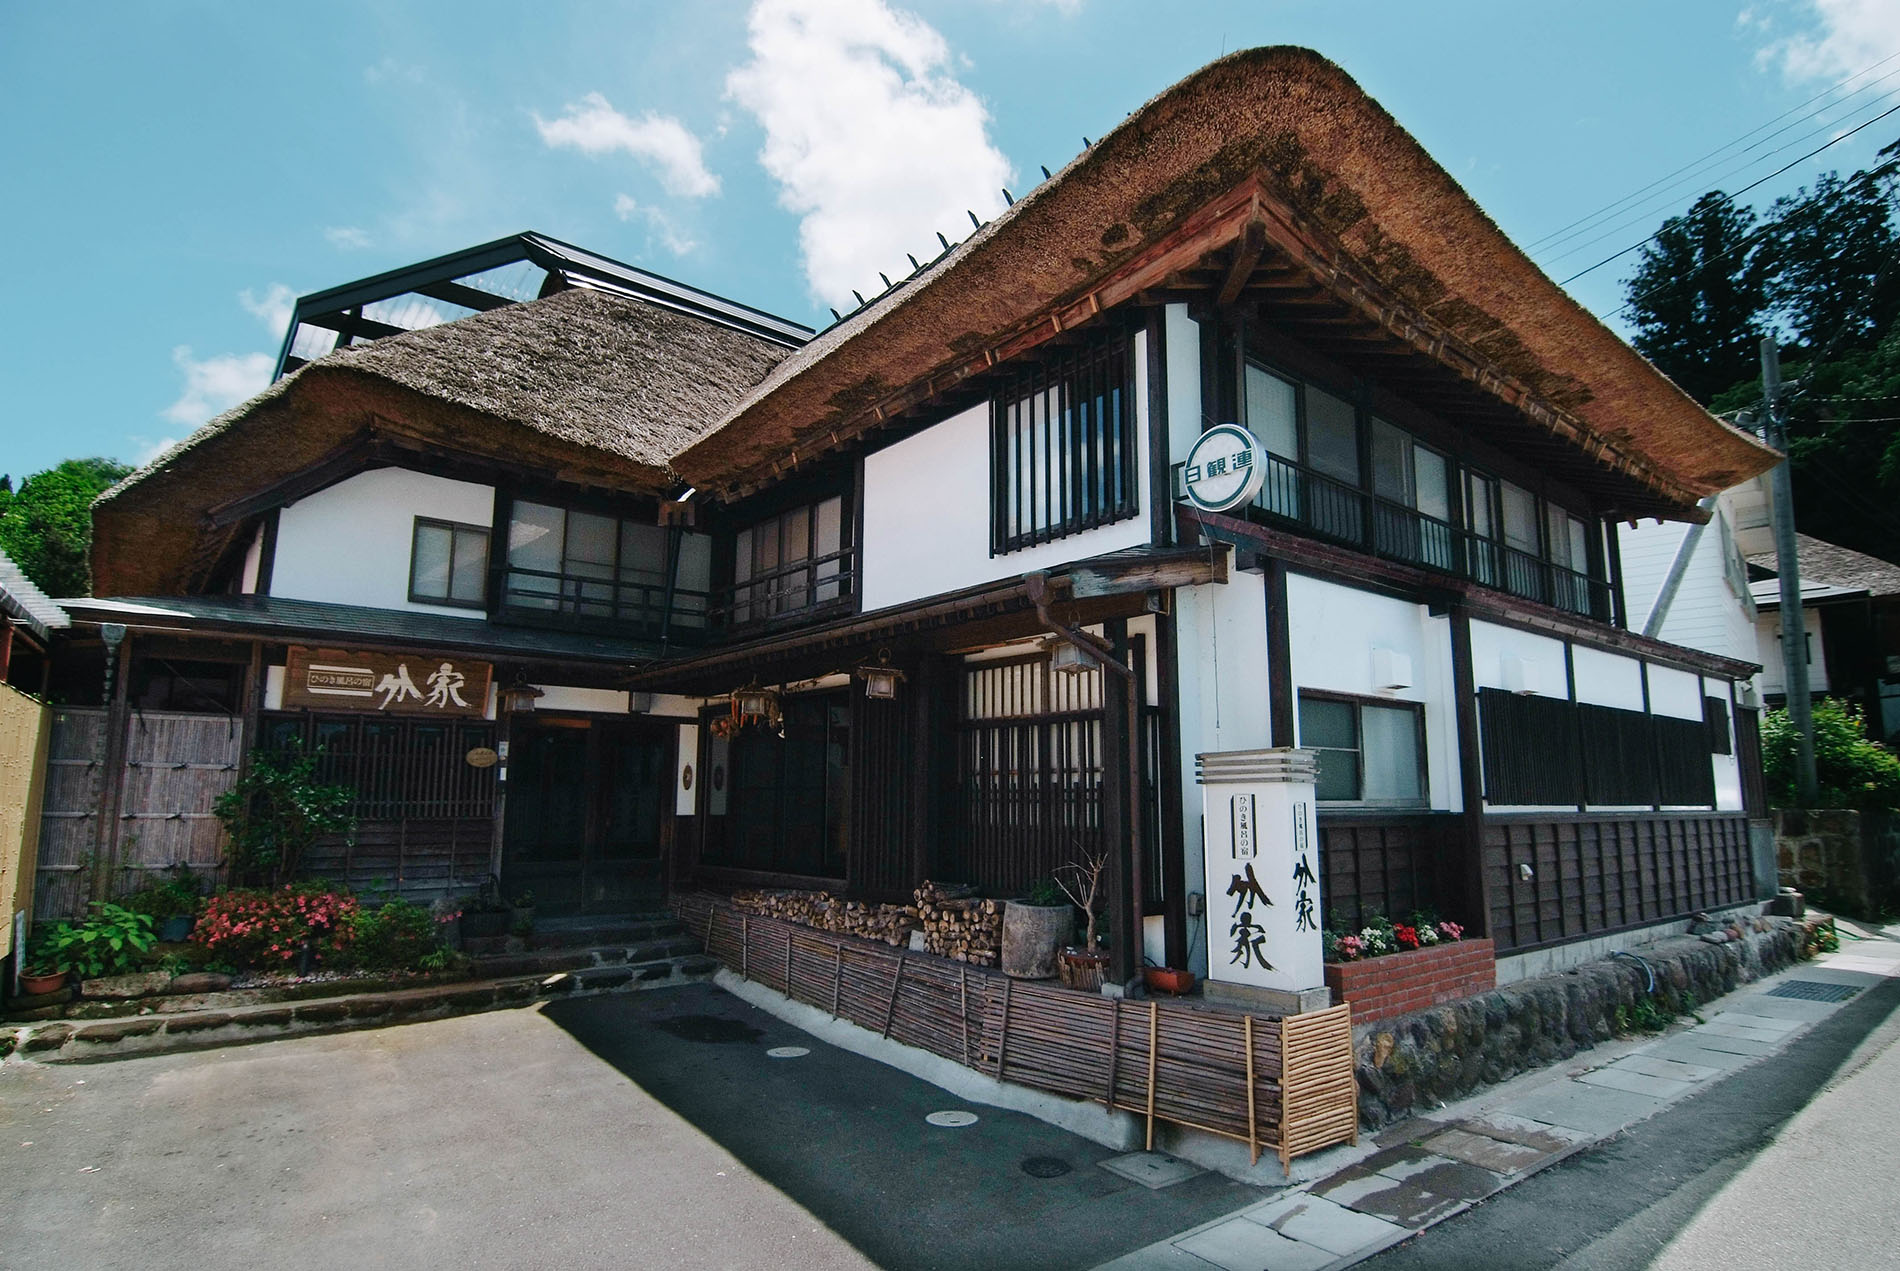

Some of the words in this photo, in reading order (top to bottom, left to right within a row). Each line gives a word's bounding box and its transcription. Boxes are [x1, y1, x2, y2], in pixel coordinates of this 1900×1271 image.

[311, 674, 372, 687] ひのき風呂の宿
[1239, 796, 1249, 856] ひのき風呂の宿
